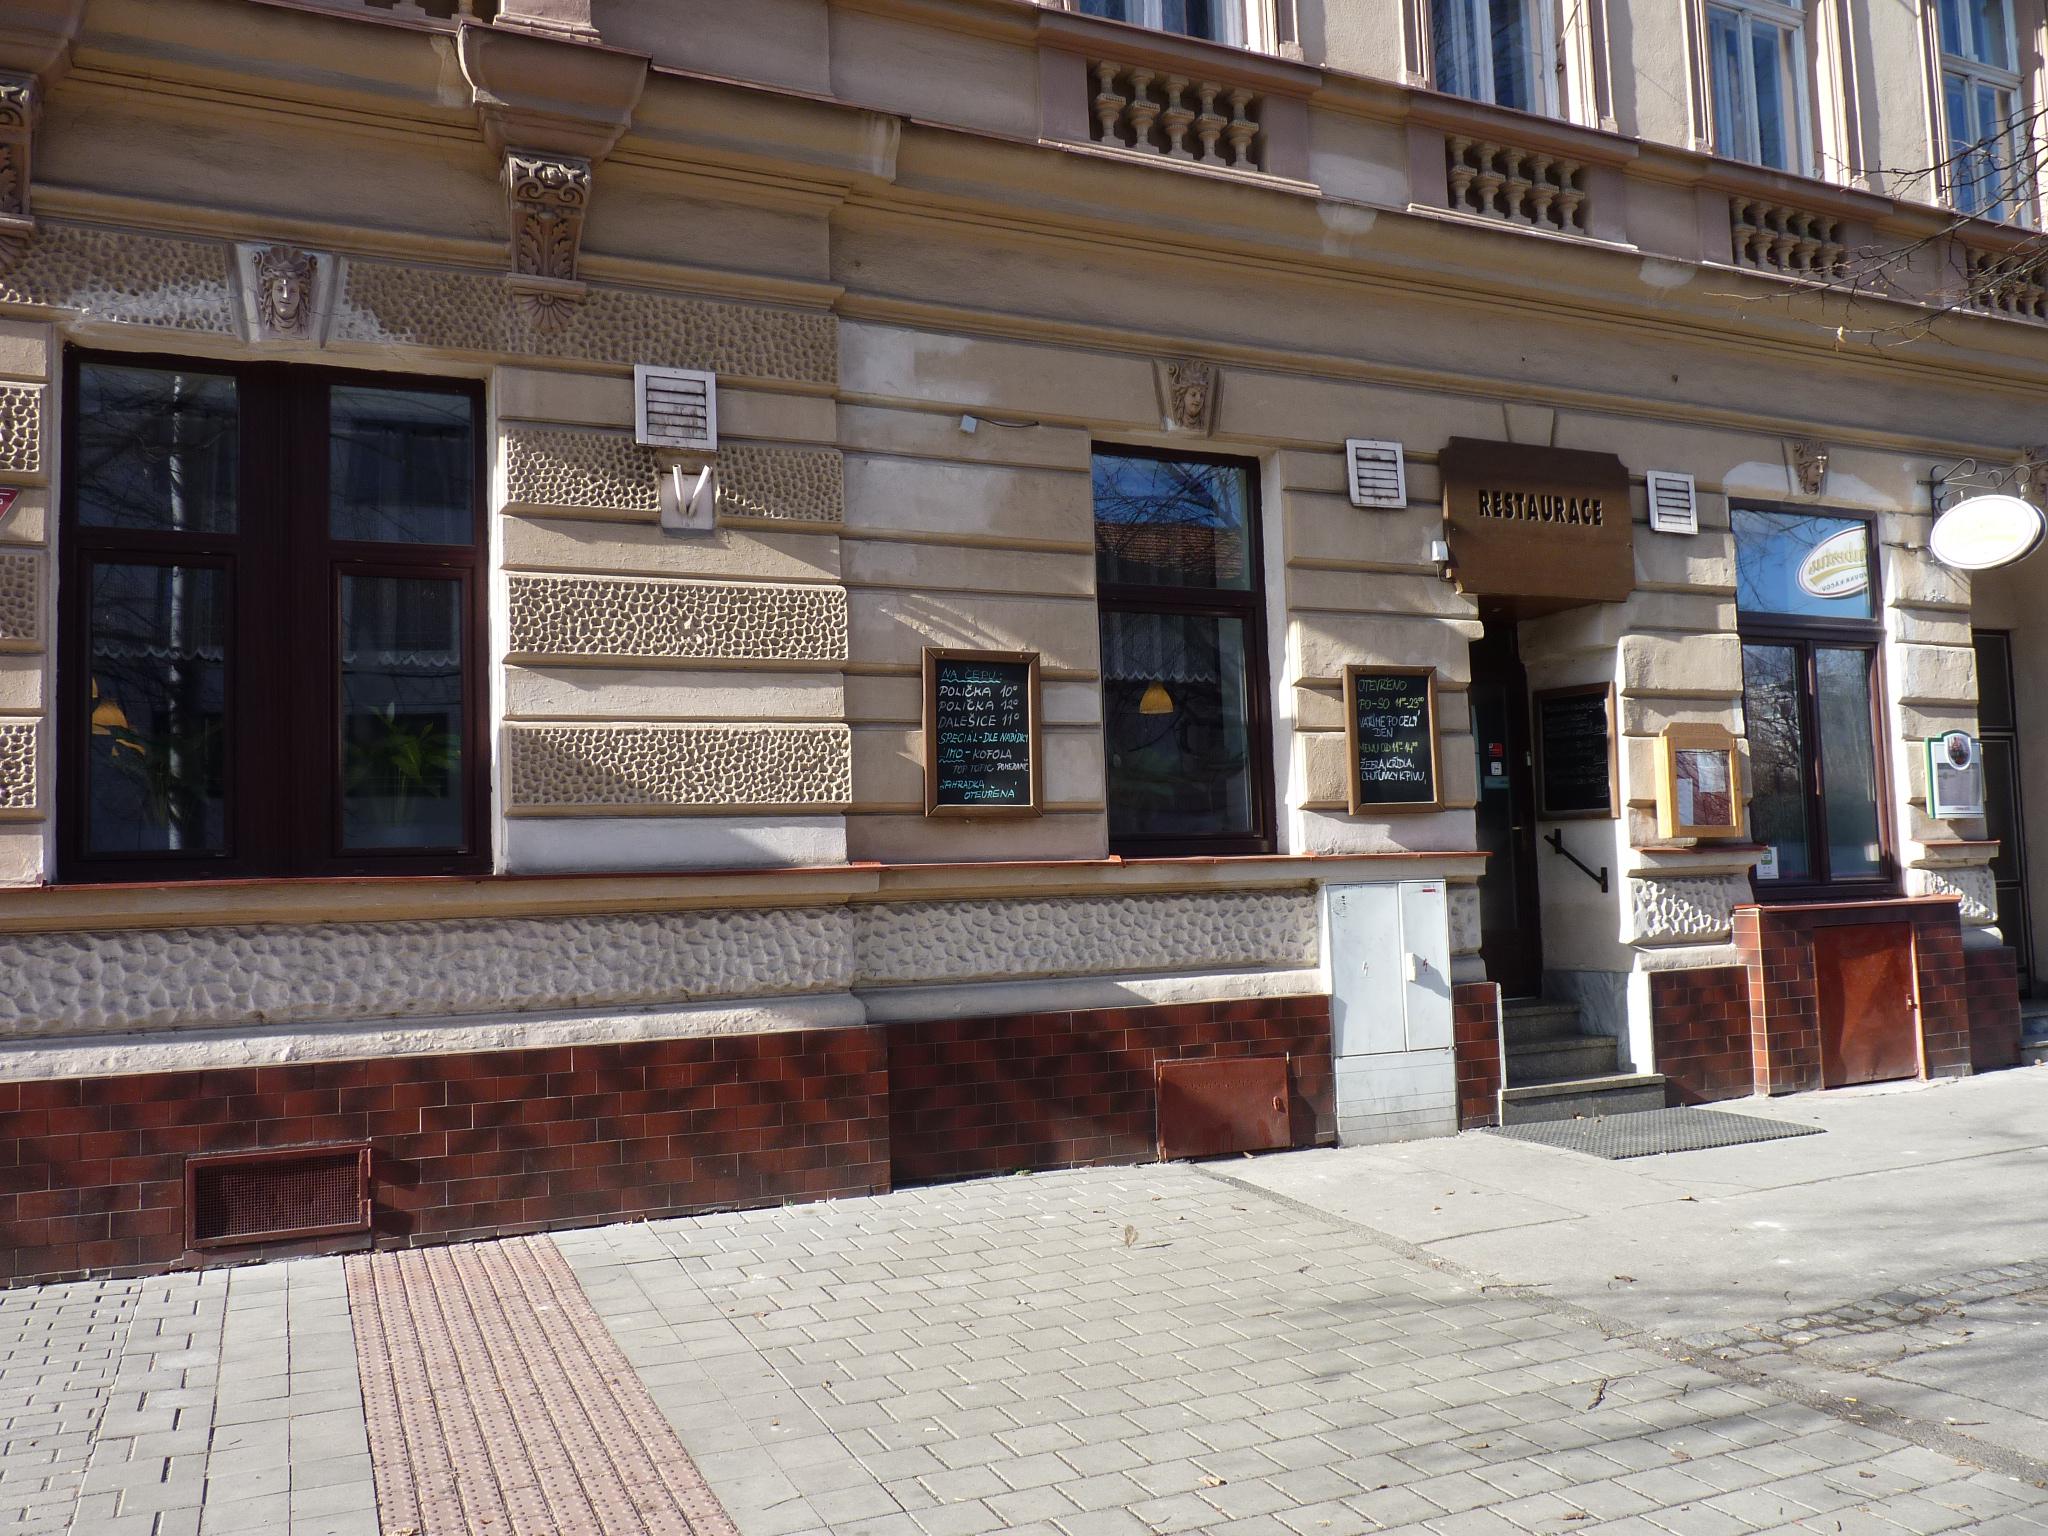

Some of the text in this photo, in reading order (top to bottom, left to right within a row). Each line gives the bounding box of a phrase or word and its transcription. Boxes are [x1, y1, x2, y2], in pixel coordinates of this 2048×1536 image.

[1478, 489, 1604, 526] RESTAURACE
[942, 667, 958, 679] NA
[939, 684, 992, 698] POLIČKA
[1358, 677, 1408, 692] OTEVŘENO
[938, 699, 994, 713] POLIČKA
[938, 713, 997, 729] DALEŠICE
[1372, 727, 1394, 738] DEN
[972, 748, 1012, 760] KOFOLA
